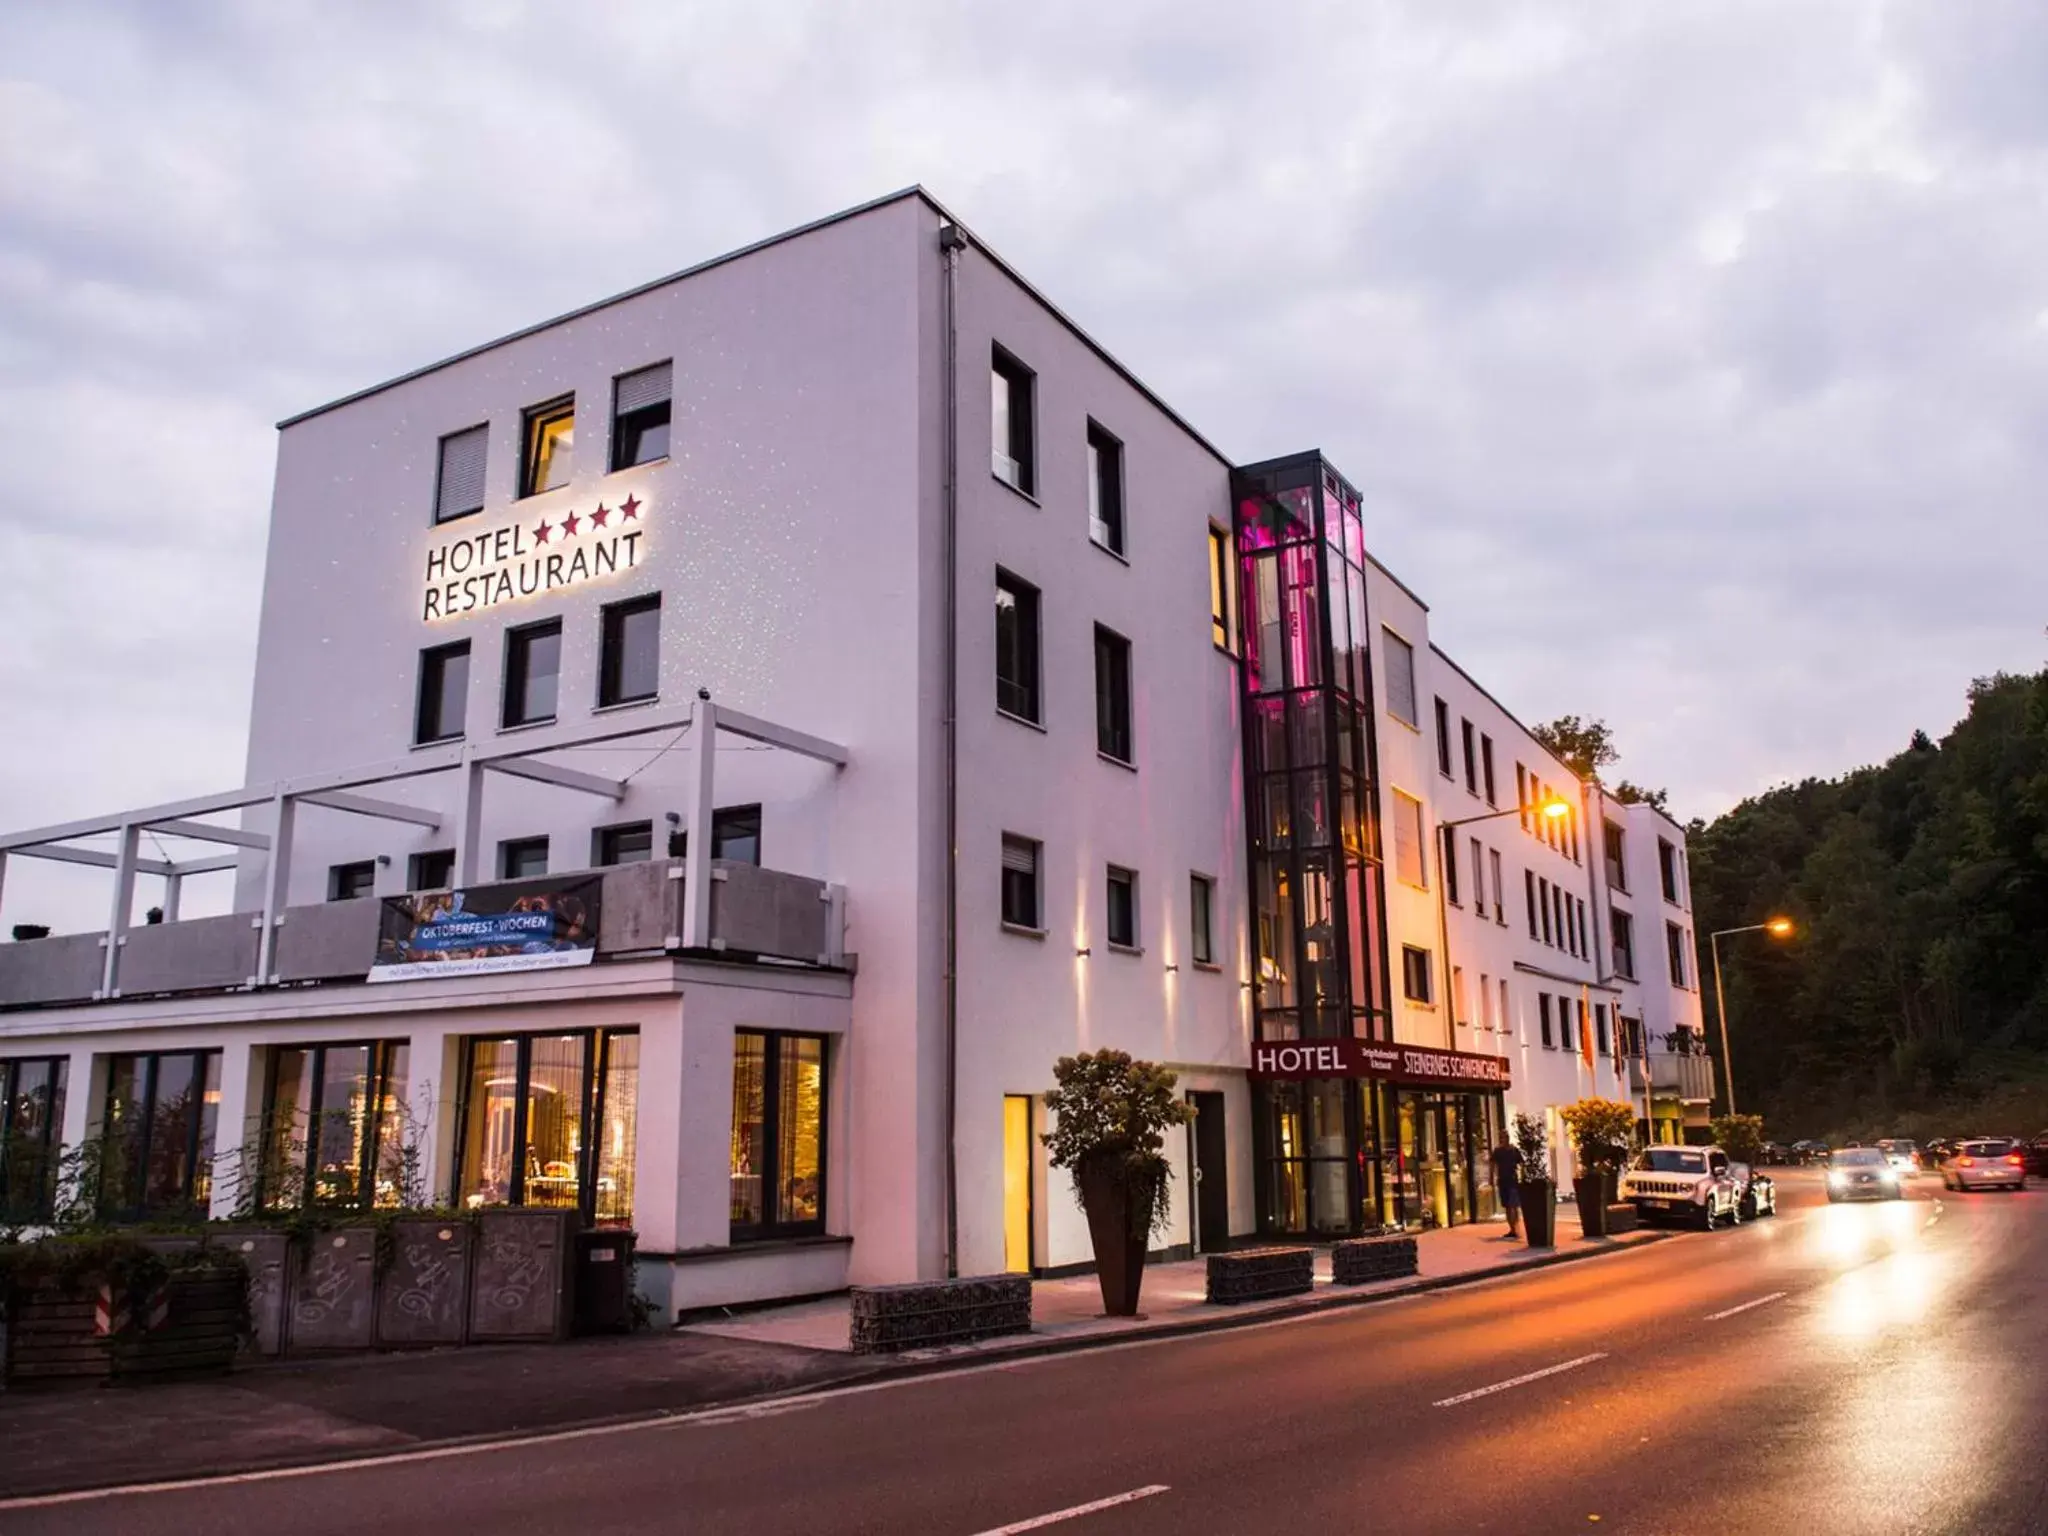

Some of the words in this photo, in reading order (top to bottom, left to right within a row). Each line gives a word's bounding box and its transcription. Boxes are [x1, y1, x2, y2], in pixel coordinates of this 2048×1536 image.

[426, 524, 526, 581] HOTEL
[423, 530, 643, 621] RESTAURANT
[1257, 1046, 1347, 1072] HOTEL
[1404, 1050, 1450, 1077] STEINERNES
[1450, 1057, 1500, 1081] SCHWEINCHEN
